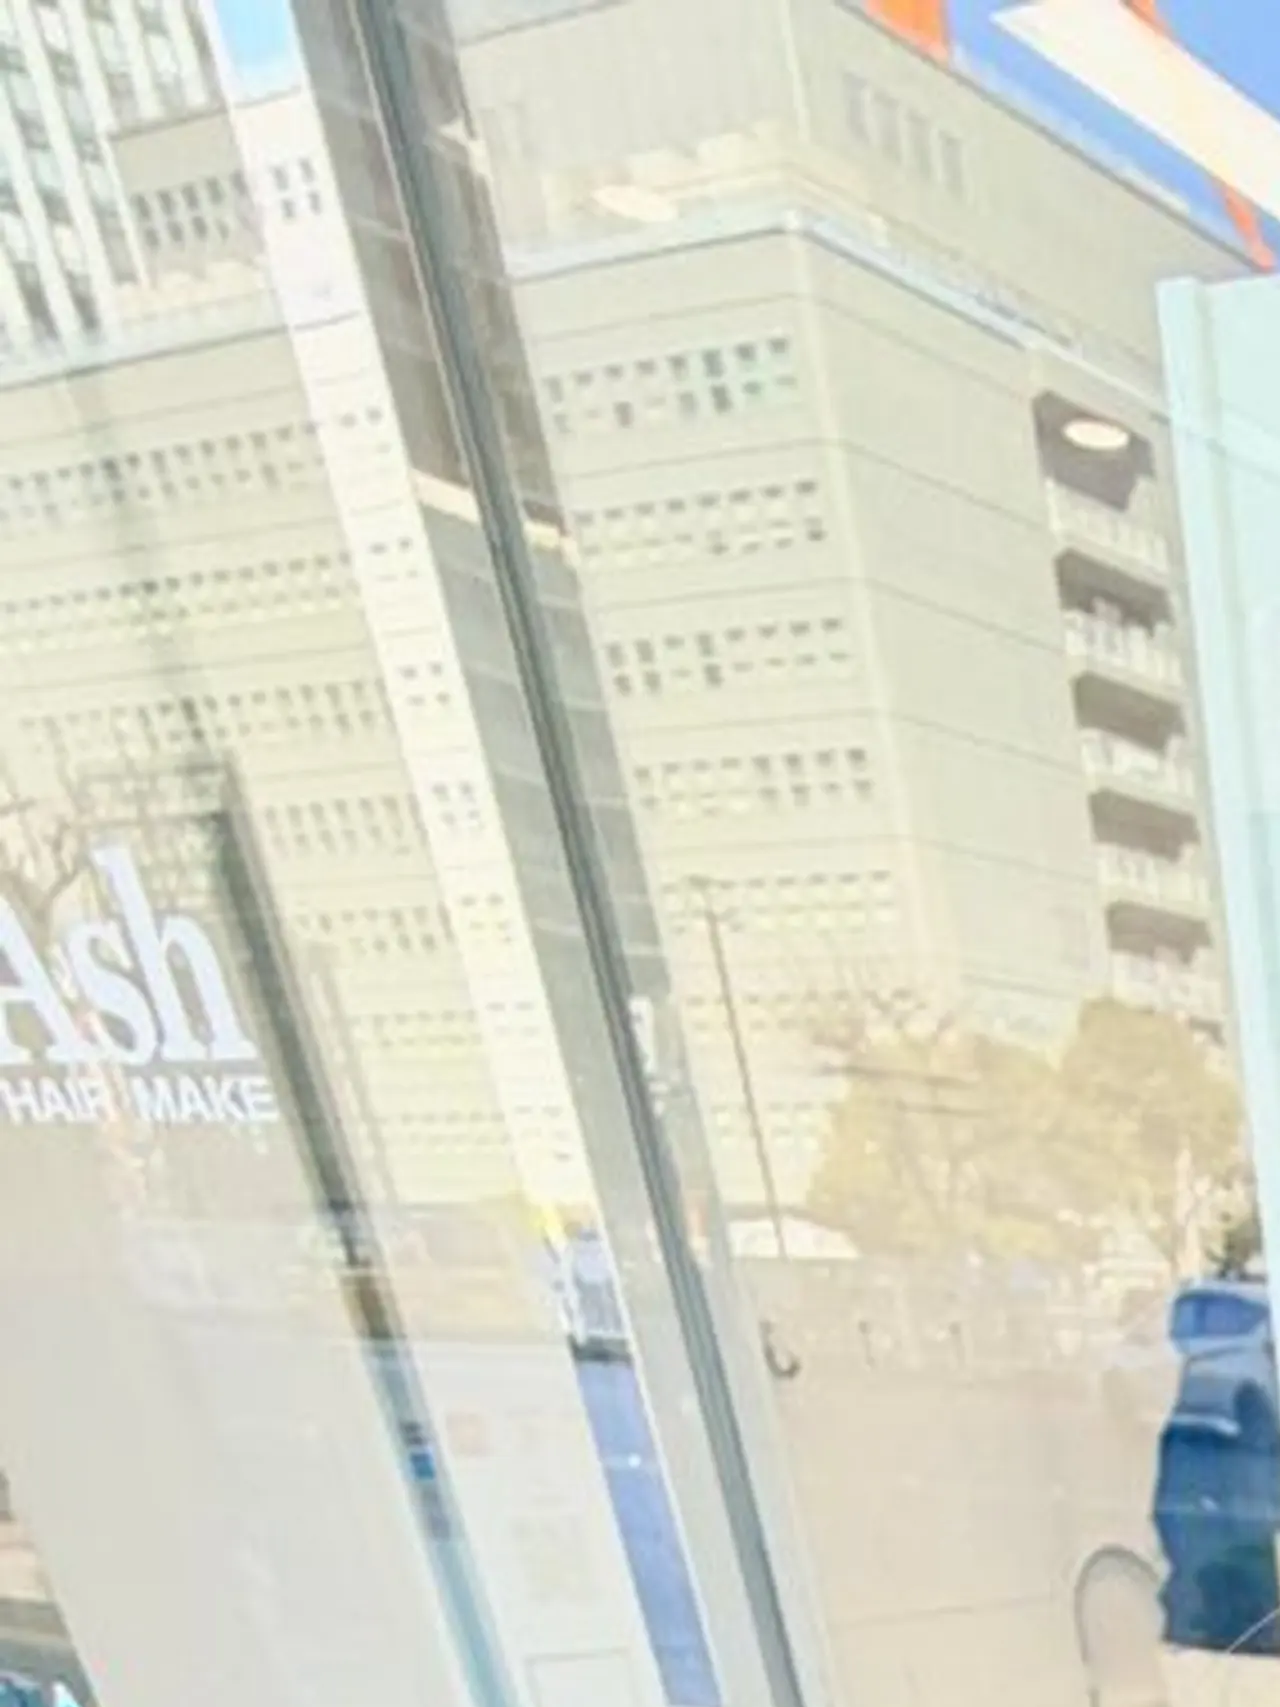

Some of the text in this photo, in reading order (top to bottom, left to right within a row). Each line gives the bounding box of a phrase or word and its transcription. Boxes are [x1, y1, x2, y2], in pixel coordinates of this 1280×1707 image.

[0, 840, 259, 1065] Ash
[0, 1073, 281, 1125] HAIR MAKE
